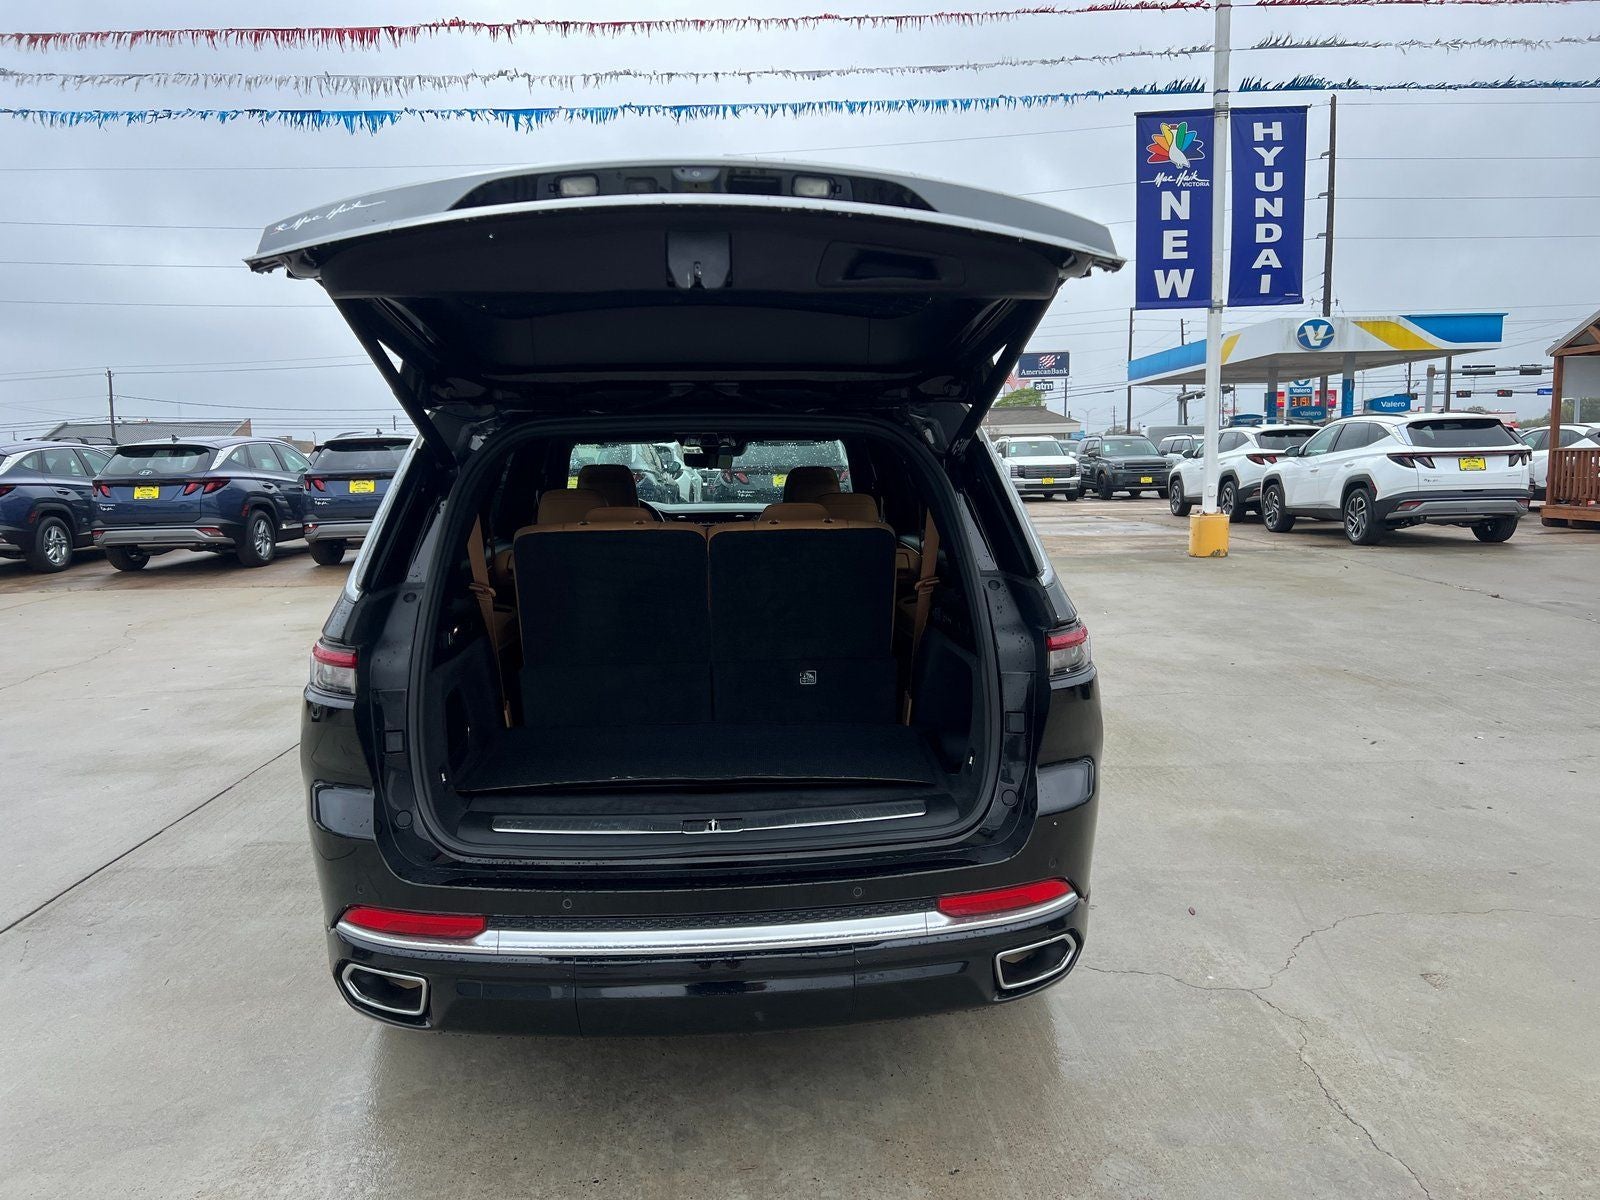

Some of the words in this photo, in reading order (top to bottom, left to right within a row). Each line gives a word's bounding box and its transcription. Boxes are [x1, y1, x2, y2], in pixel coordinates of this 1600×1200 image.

[1154, 172, 1176, 187] Mac
[1175, 170, 1209, 187] Haik
[1252, 121, 1284, 294] HYUNDAI
[1154, 190, 1194, 298] NEW
[1021, 368, 1068, 376] AmericanBank
